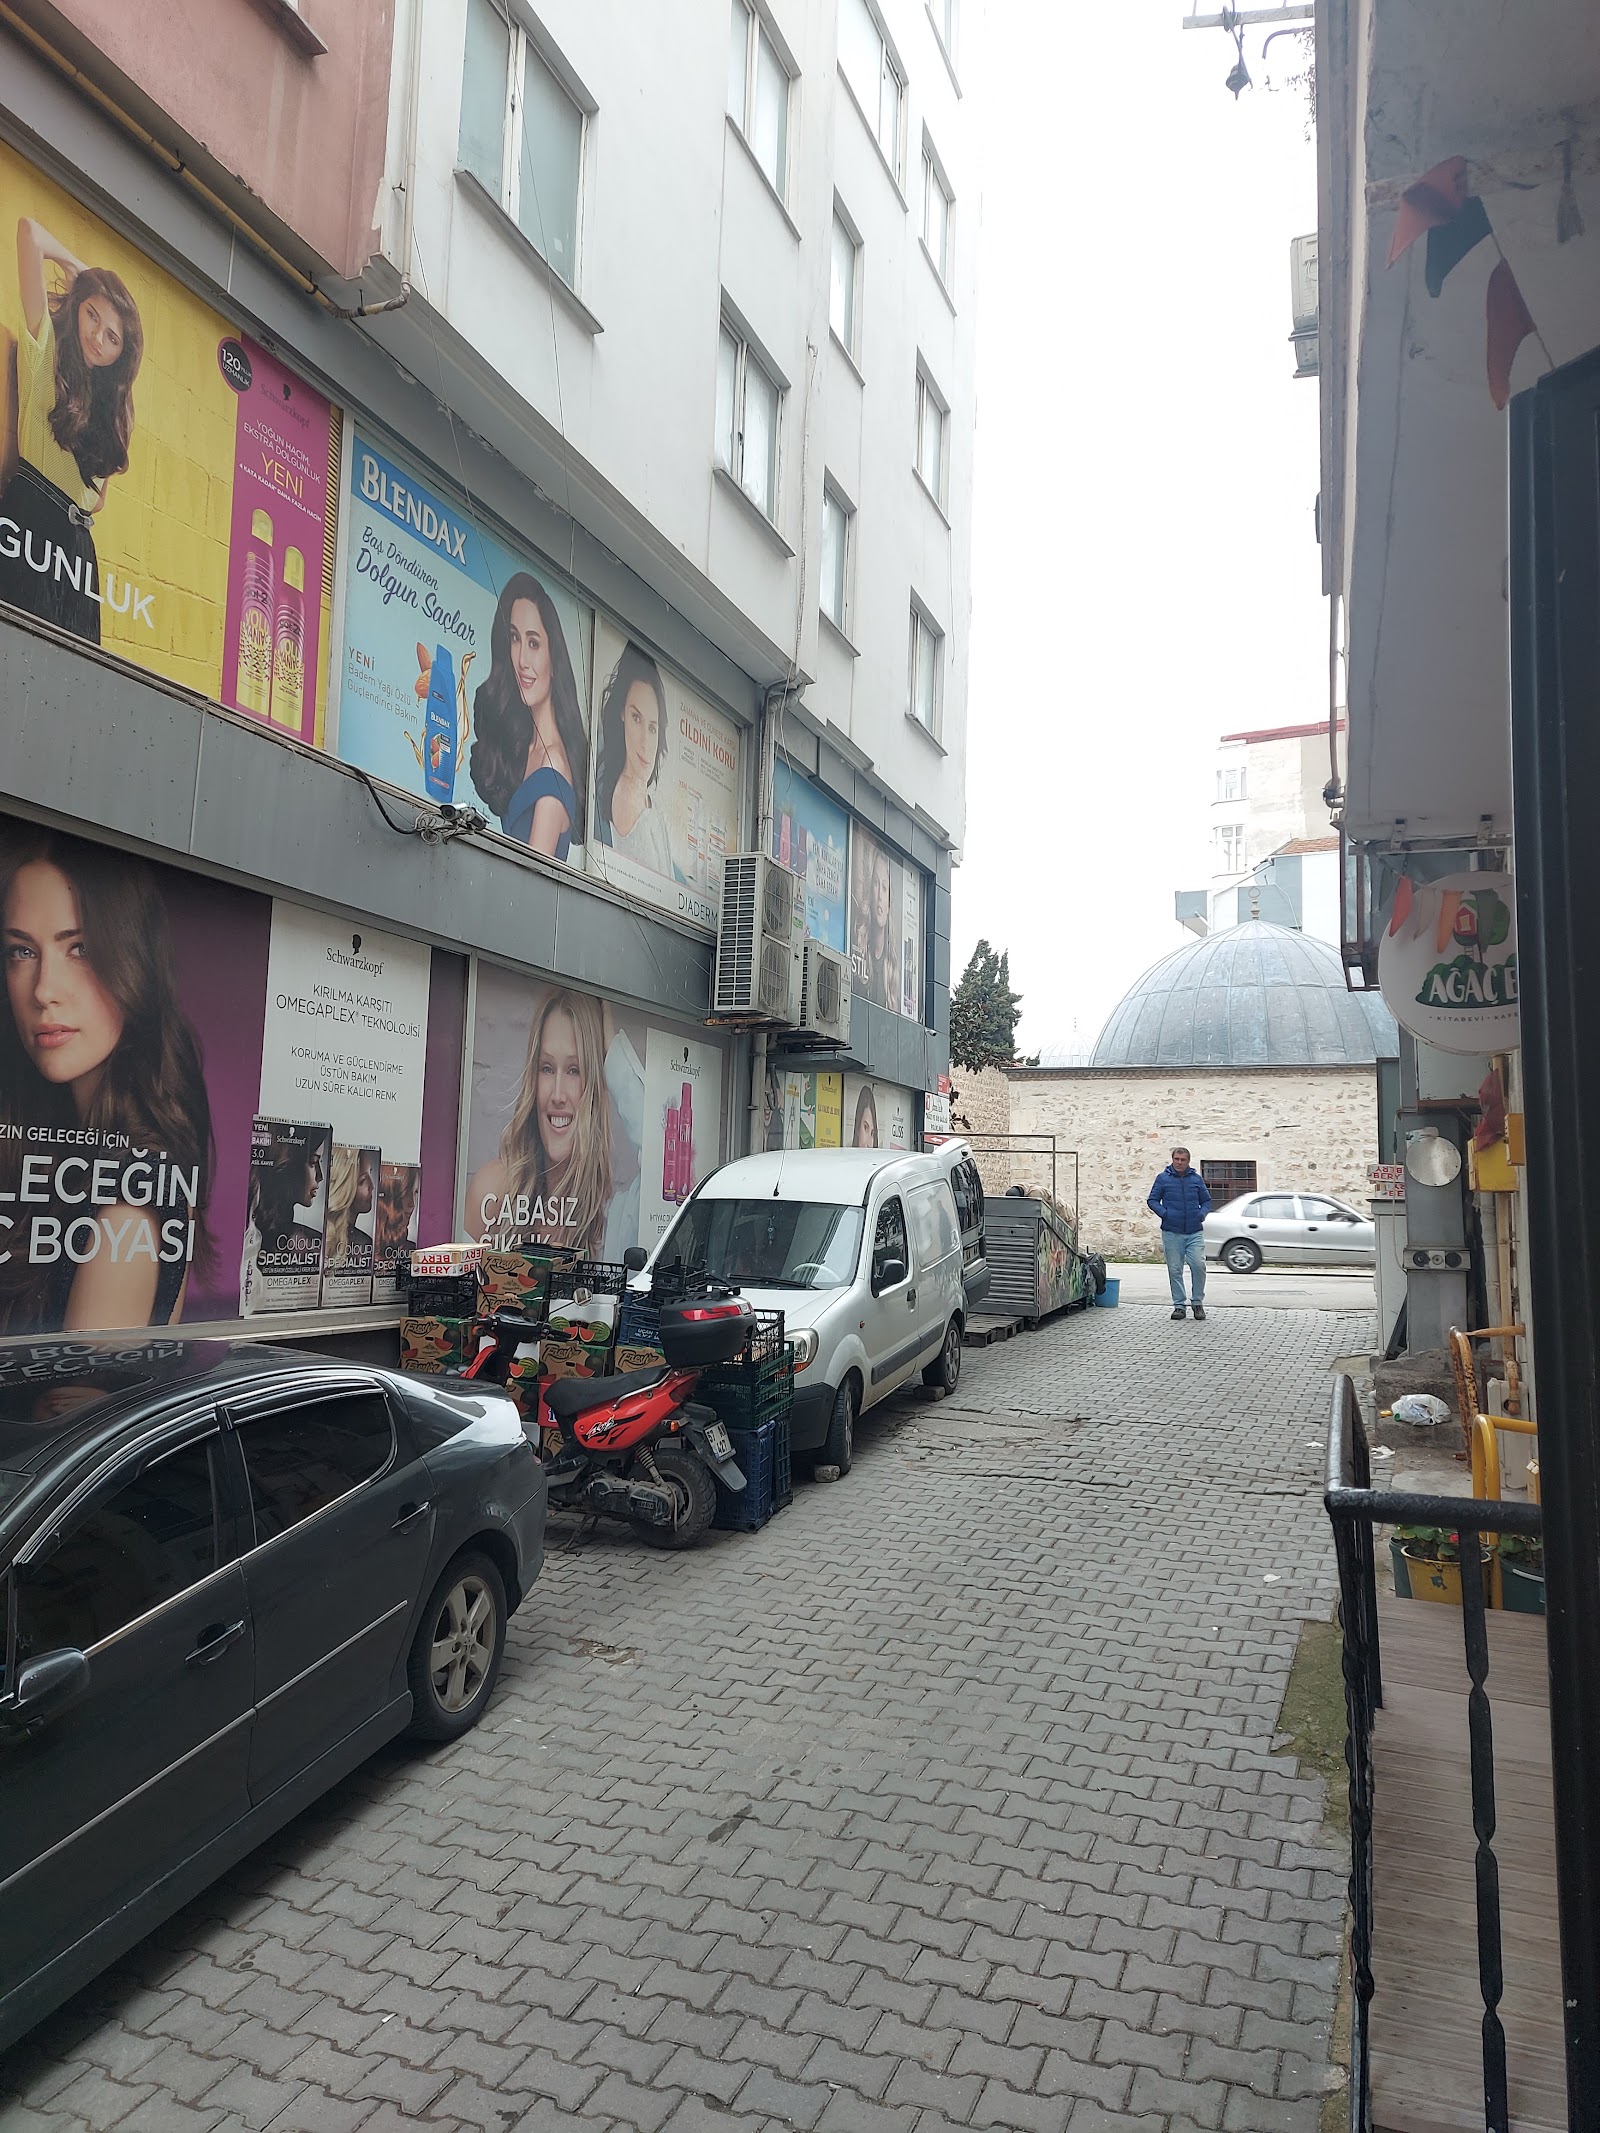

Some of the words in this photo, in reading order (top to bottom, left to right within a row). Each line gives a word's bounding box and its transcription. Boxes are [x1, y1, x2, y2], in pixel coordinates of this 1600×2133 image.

[222, 349, 241, 371] 120
[223, 363, 250, 387] UZMANLIK
[261, 384, 310, 430] Schwarzkopf
[256, 420, 285, 447] YOĞUN
[243, 422, 275, 451] EKSTRA
[275, 445, 321, 484] DOLGUNLUK
[261, 452, 304, 499] YENİ
[360, 454, 467, 567] BLENDAX
[362, 525, 384, 555] Baş
[386, 542, 439, 591] Döndüren
[356, 547, 418, 605] Dolgun
[421, 592, 475, 646] Saçlar
[348, 646, 375, 671] YENİ
[348, 662, 376, 688] Badem
[377, 678, 393, 699] Yağı
[347, 677, 393, 712] Güçlendirici
[394, 703, 418, 725] Bakım
[430, 711, 451, 730] BLENDAX
[680, 718, 711, 753] CİLDİNİ
[713, 742, 736, 771] KORU
[326, 947, 384, 977] Schwarzkopf
[851, 953, 869, 979] STİL
[313, 984, 354, 1005] KIRILMA
[356, 994, 393, 1014] KARŞITI
[1429, 967, 1498, 1005] AĞAÇ
[362, 1014, 420, 1038] TEKNOLOJİSİ
[291, 1046, 331, 1063] KORUMA
[333, 1053, 344, 1065] VE
[347, 1056, 403, 1075] GÜÇLENDİRME
[670, 1059, 701, 1080] Schwarzkopf
[320, 1065, 349, 1081] ÜSTÜN
[351, 1071, 377, 1084] BAKIM
[295, 1077, 320, 1091] UZUN
[322, 1081, 345, 1095] SÜRE
[347, 1085, 373, 1099] KALICI
[375, 1089, 397, 1101] RENK
[27, 1126, 100, 1146] GELECEĞİ
[102, 1131, 130, 1150] İÇİN
[254, 1123, 269, 1131] YENİ
[252, 1149, 265, 1158] 3.0
[480, 1192, 578, 1232] ÇABASIZ
[28, 1216, 195, 1264] BOYASI
[258, 1250, 320, 1266] SPECIALIST
[324, 1256, 371, 1270] SPECIALIST
[421, 1266, 450, 1274] BERY
[267, 1277, 312, 1286] OMEGAPLEX
[328, 1278, 364, 1286] OMEGAPLEX
